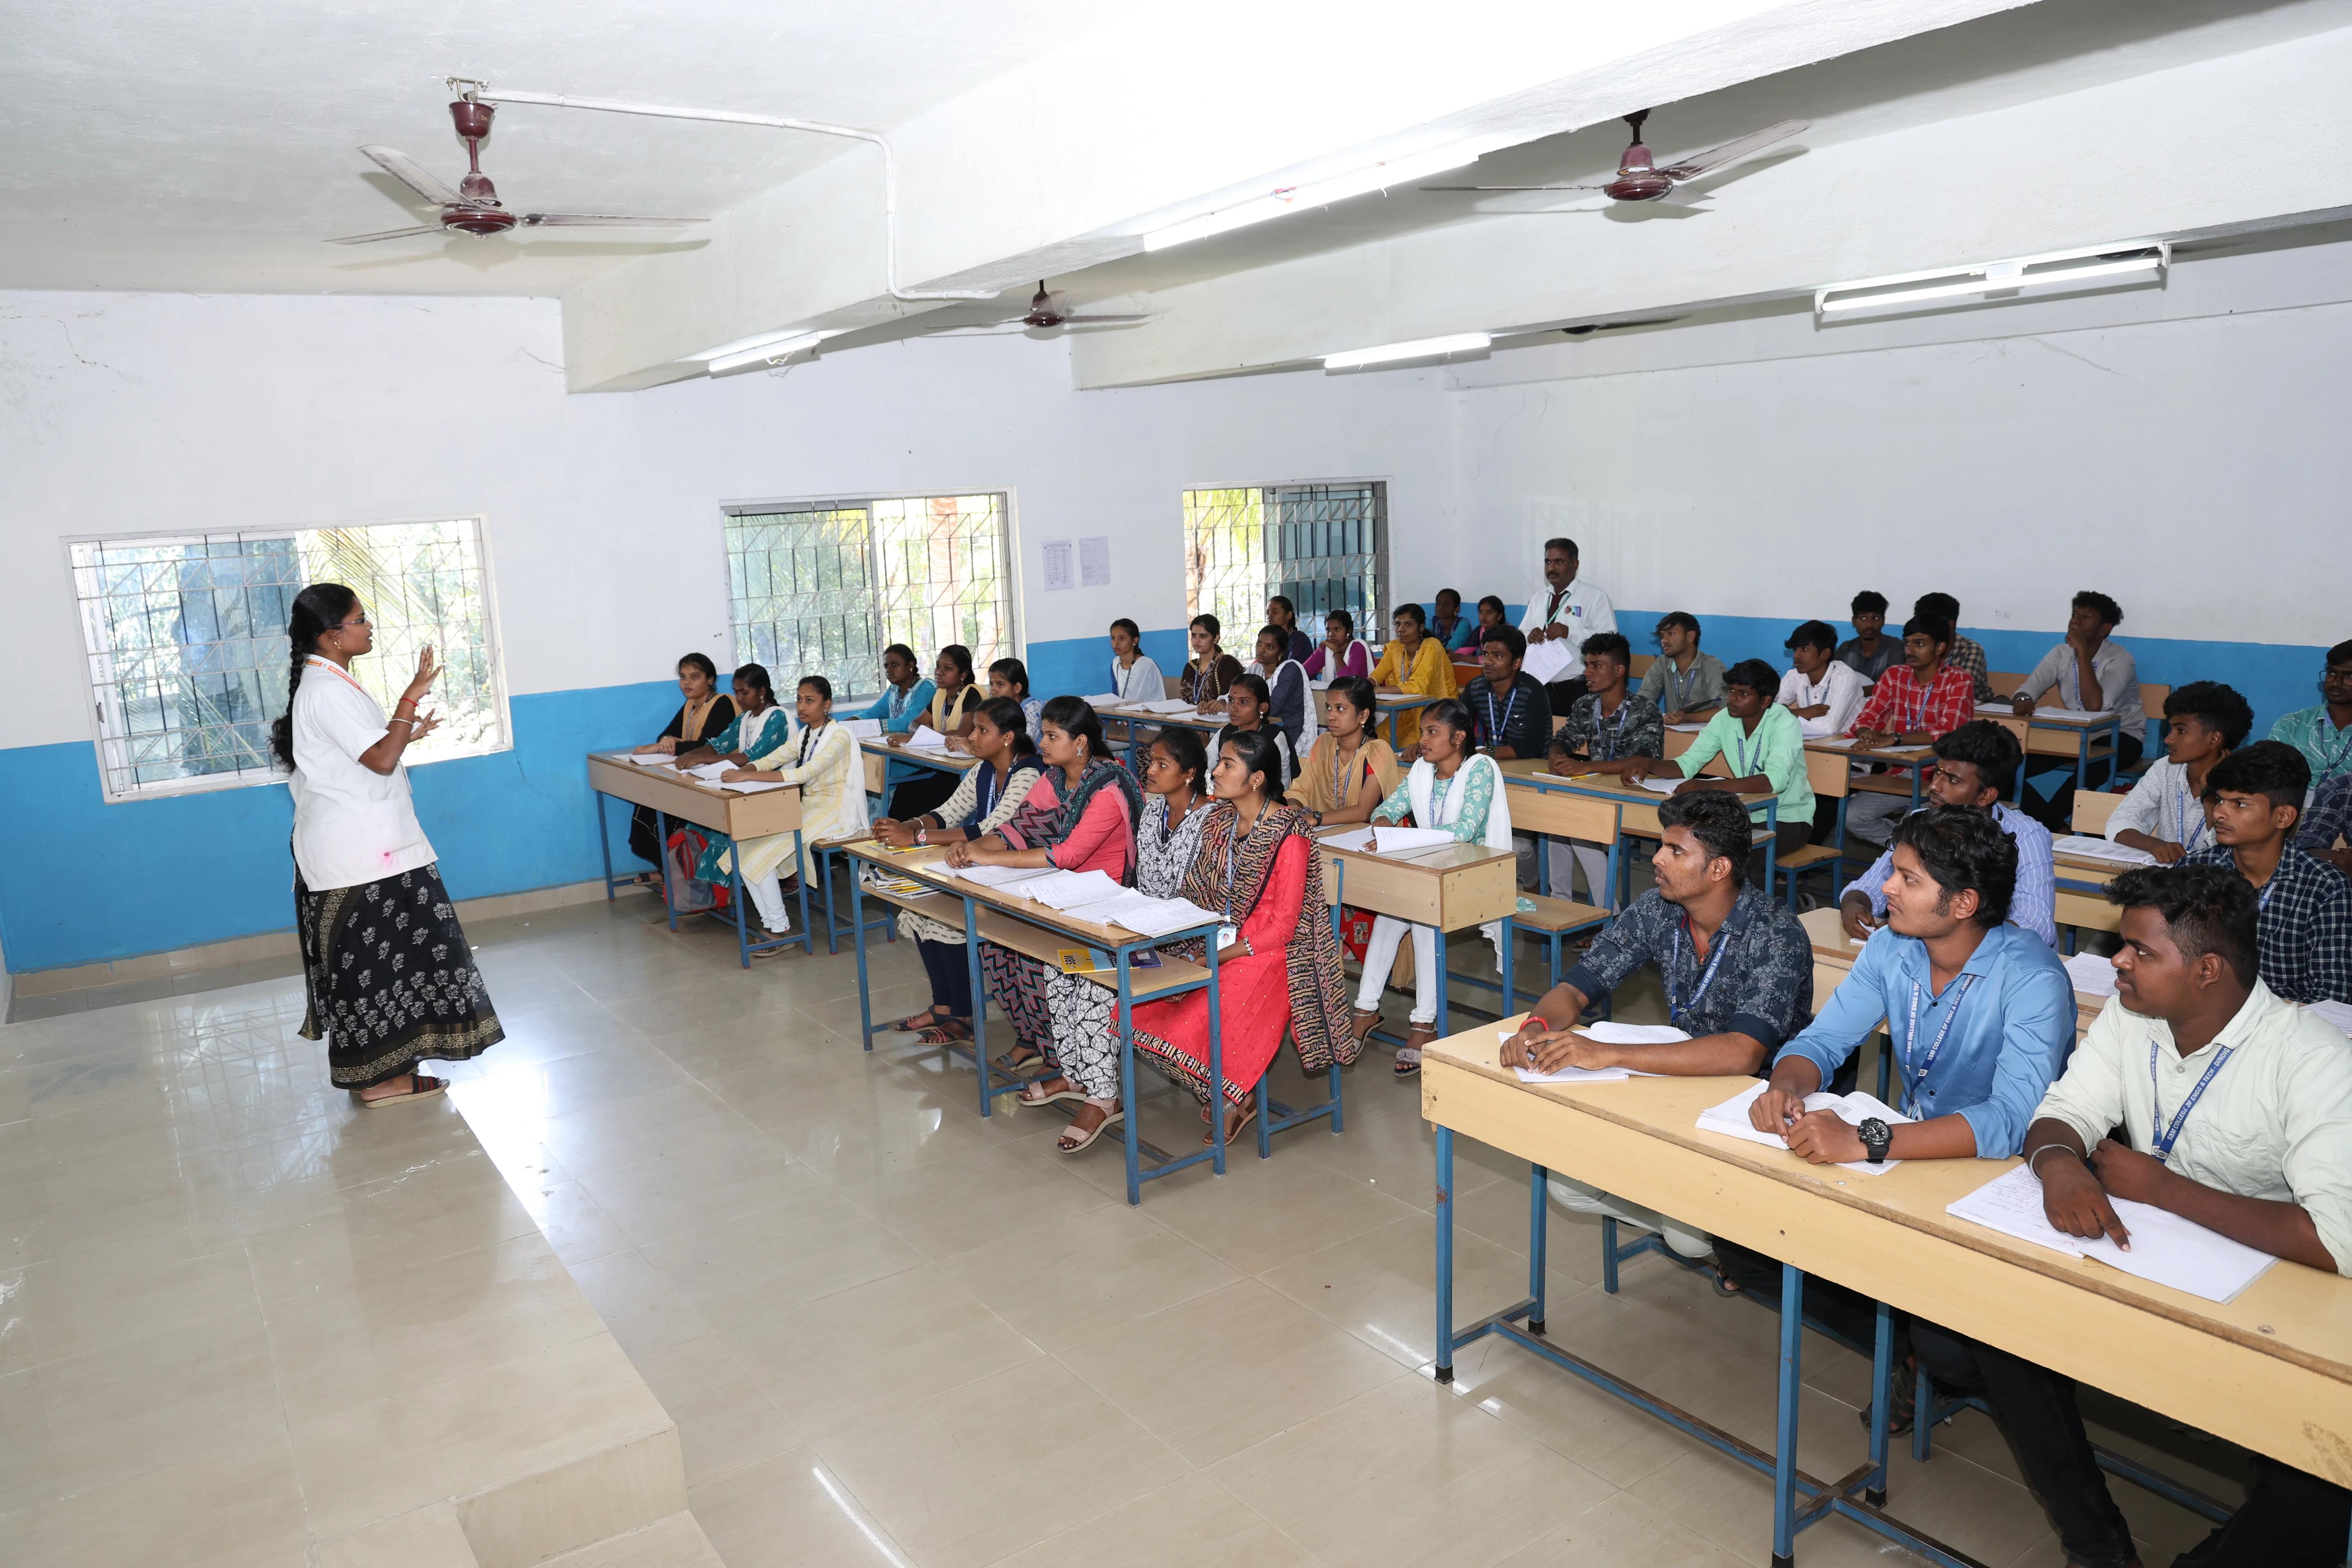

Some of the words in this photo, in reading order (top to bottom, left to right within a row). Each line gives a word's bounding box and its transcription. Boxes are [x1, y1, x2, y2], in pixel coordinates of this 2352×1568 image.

[2264, 882, 2277, 899] DINDIGUL
[1063, 955, 1076, 965] SBM
[1694, 982, 1707, 1000] COLLEGE
[1705, 965, 1715, 978] ENGG
[1713, 952, 1723, 963] TECH
[1908, 1018, 1916, 1041] COLLEGE
[1927, 1051, 1936, 1061] SBM
[1932, 1029, 1945, 1050] COLLEGE
[1945, 1010, 1954, 1023] ENGG
[1953, 993, 1961, 1006] TECH
[1960, 975, 1973, 991] DINDIG
[2167, 1128, 2177, 1141] SBM
[2173, 1105, 2188, 1130] COLLEGE
[2185, 1099, 2192, 1108] OF
[2190, 1086, 2202, 1101] ENGG
[2202, 1068, 2215, 1083] TECH
